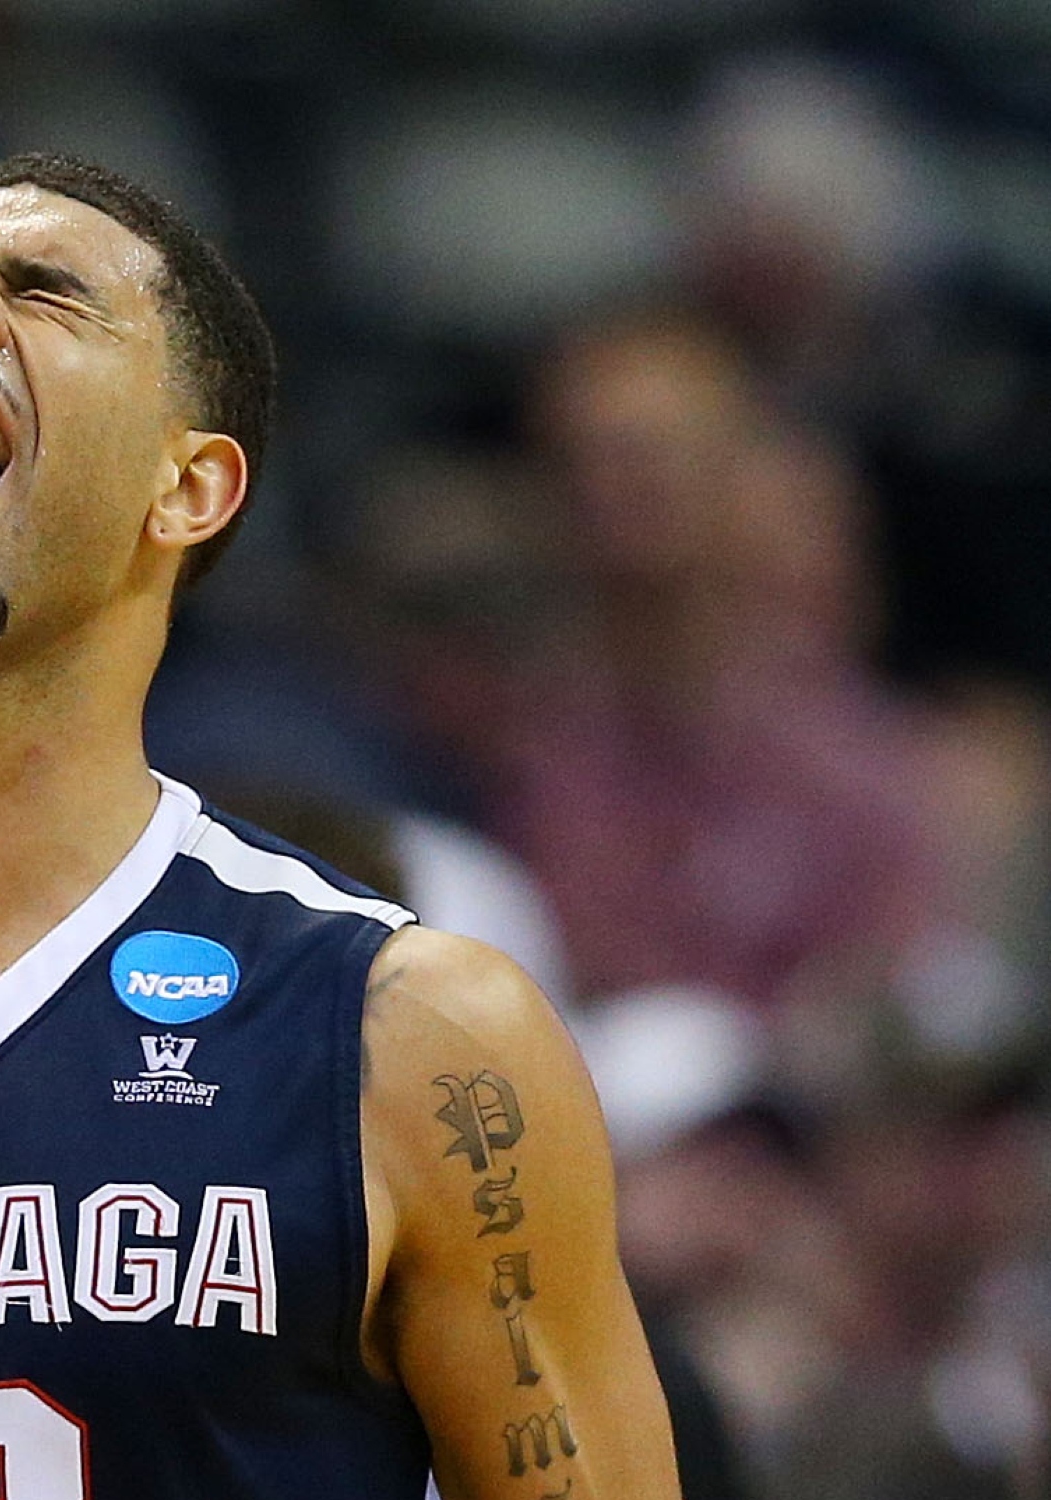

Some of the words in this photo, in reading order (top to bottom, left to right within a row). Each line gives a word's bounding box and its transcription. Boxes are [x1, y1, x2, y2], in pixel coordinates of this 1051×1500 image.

[126, 970, 229, 1000] NCAA
[112, 1079, 165, 1094] WEST
[164, 1079, 221, 1097] COAST
[113, 1092, 213, 1107] CONFERENCE
